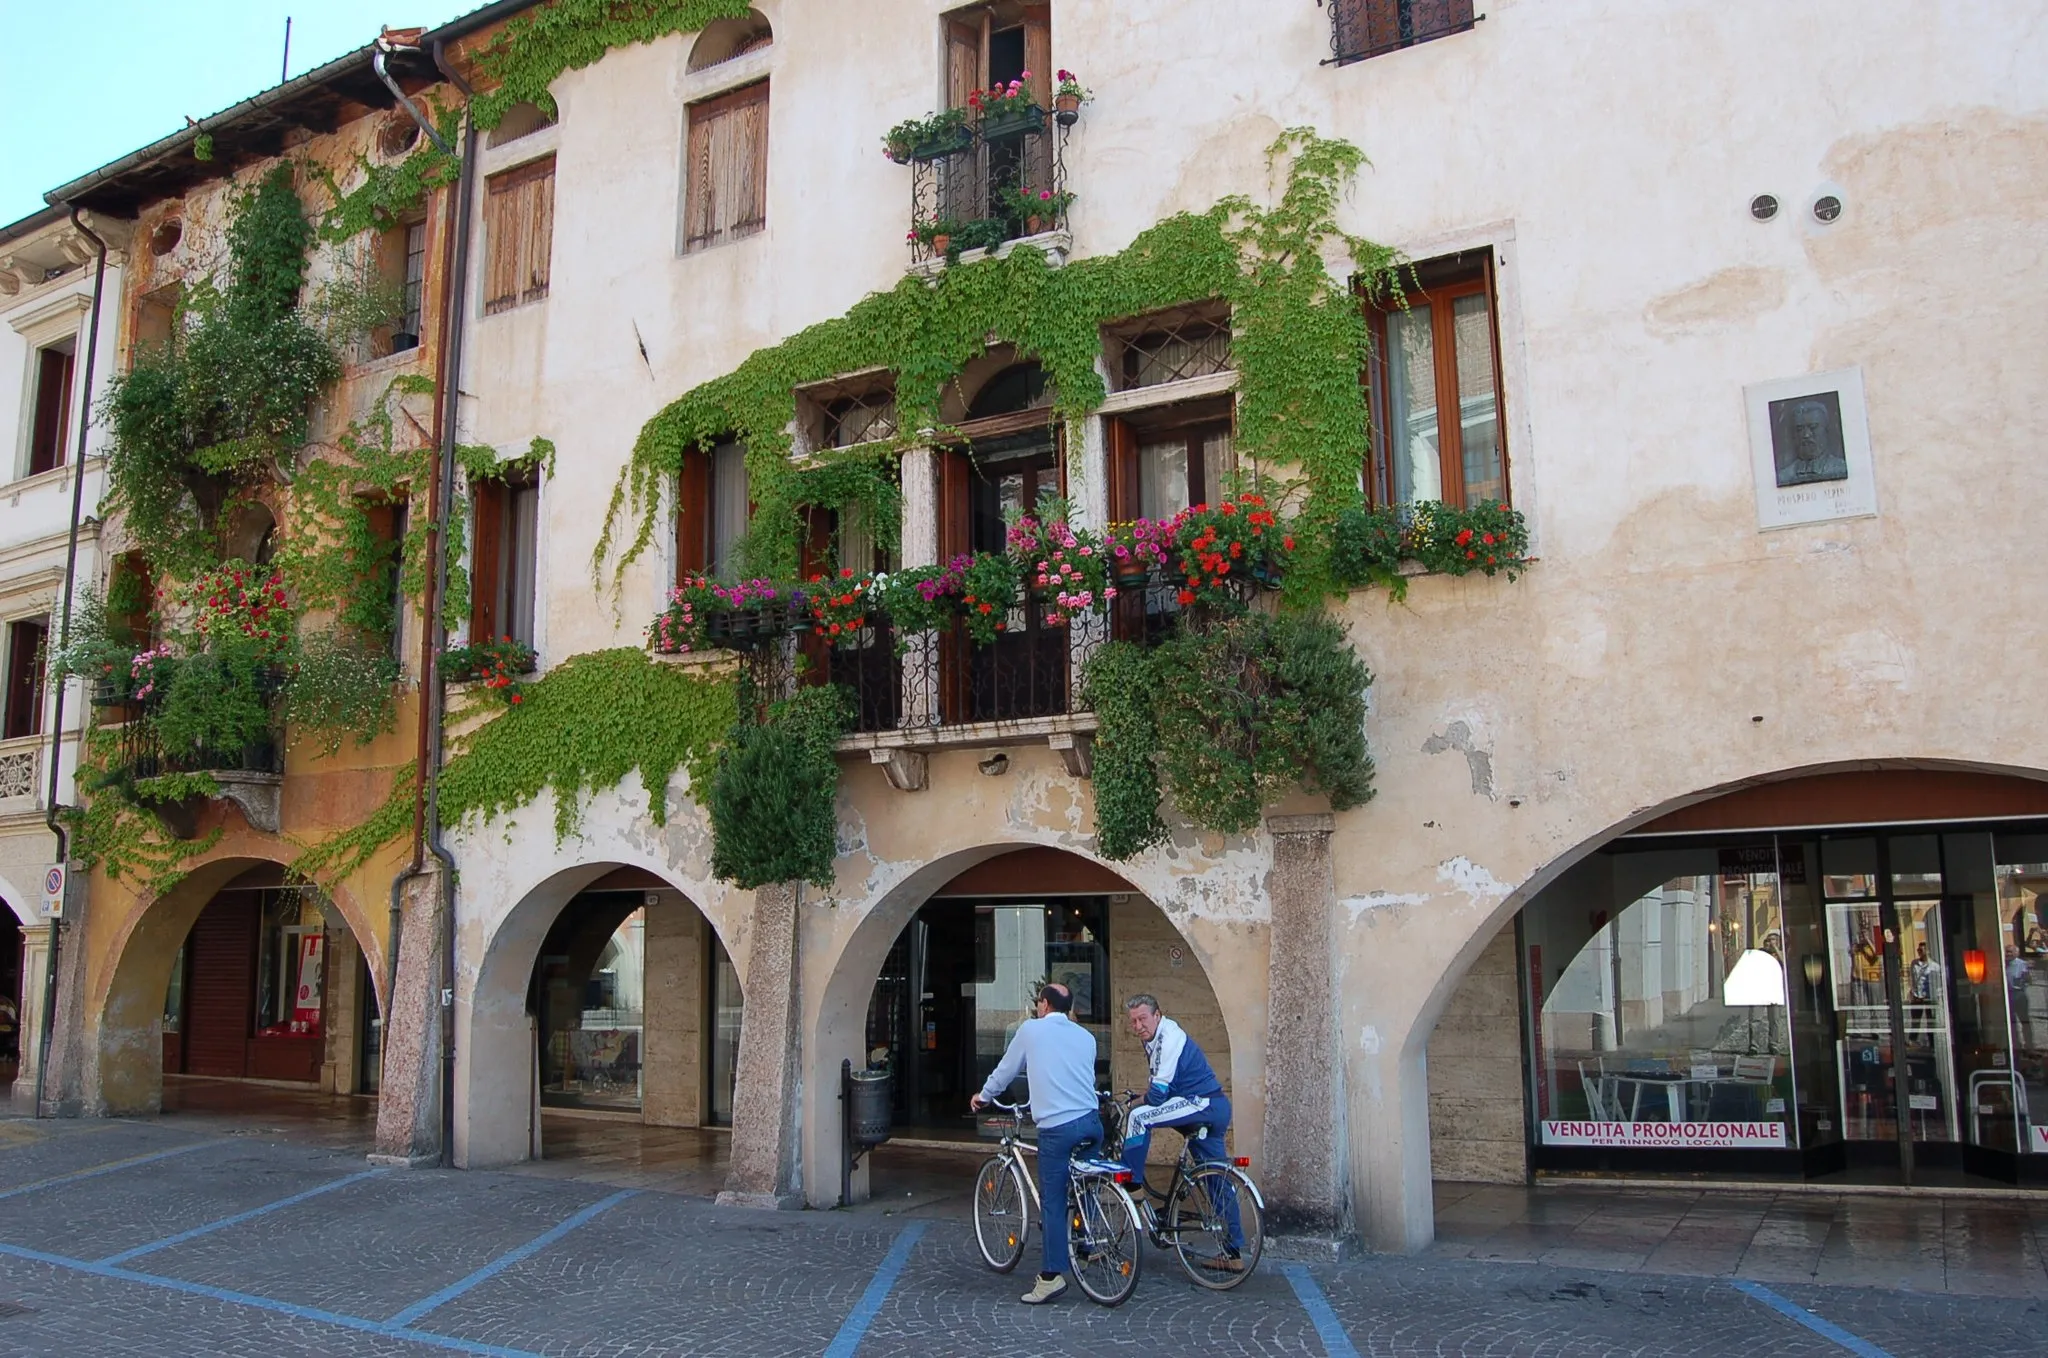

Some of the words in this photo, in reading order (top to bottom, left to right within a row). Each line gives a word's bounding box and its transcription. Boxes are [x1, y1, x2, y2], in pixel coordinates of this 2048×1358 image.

[1548, 1122, 1625, 1137] VENDITA
[1632, 1123, 1779, 1138] PROMOZIONALE
[1619, 1138, 1680, 1146] RINNOVO
